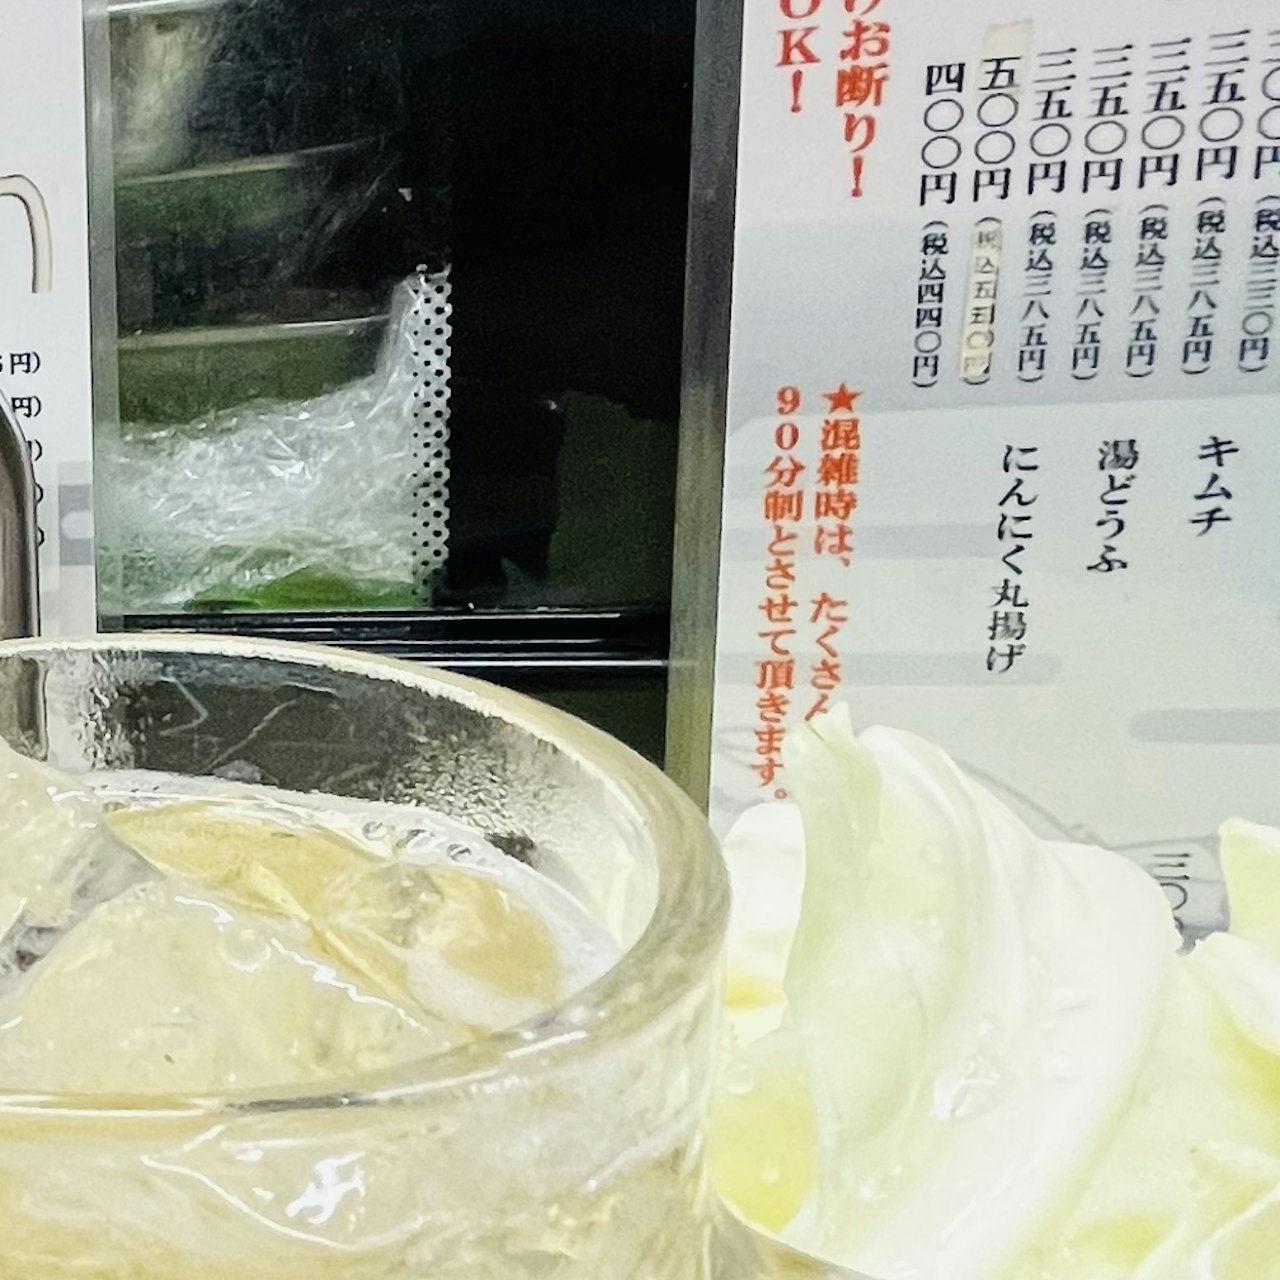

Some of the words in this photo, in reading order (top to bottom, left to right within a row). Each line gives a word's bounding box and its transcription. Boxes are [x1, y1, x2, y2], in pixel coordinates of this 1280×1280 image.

[1086, 439, 1139, 573] 湯どうふ
[1189, 435, 1239, 537] キムチ
[985, 443, 1040, 675] にんにく丸揚げ
